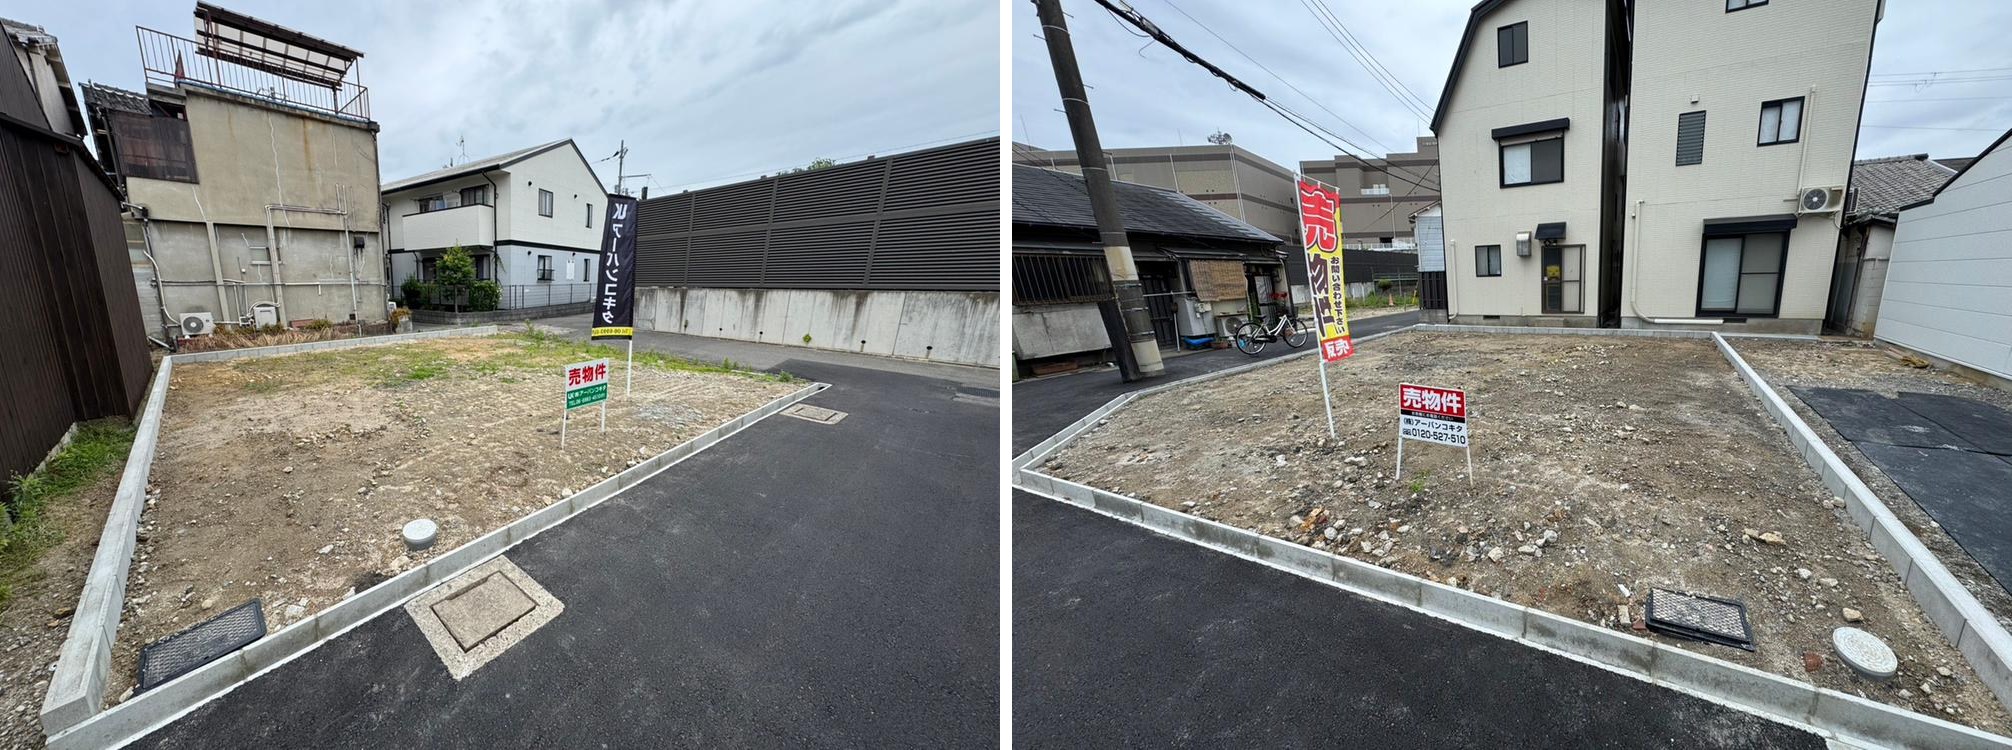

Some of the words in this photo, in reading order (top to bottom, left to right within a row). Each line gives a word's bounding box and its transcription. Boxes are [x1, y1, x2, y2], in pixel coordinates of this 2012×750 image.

[1330, 256, 1346, 334] お問い合わせ下さい
[568, 362, 607, 386] 売物件
[1402, 387, 1462, 414] 売物件
[1411, 428, 1466, 444] 0120-527-510
